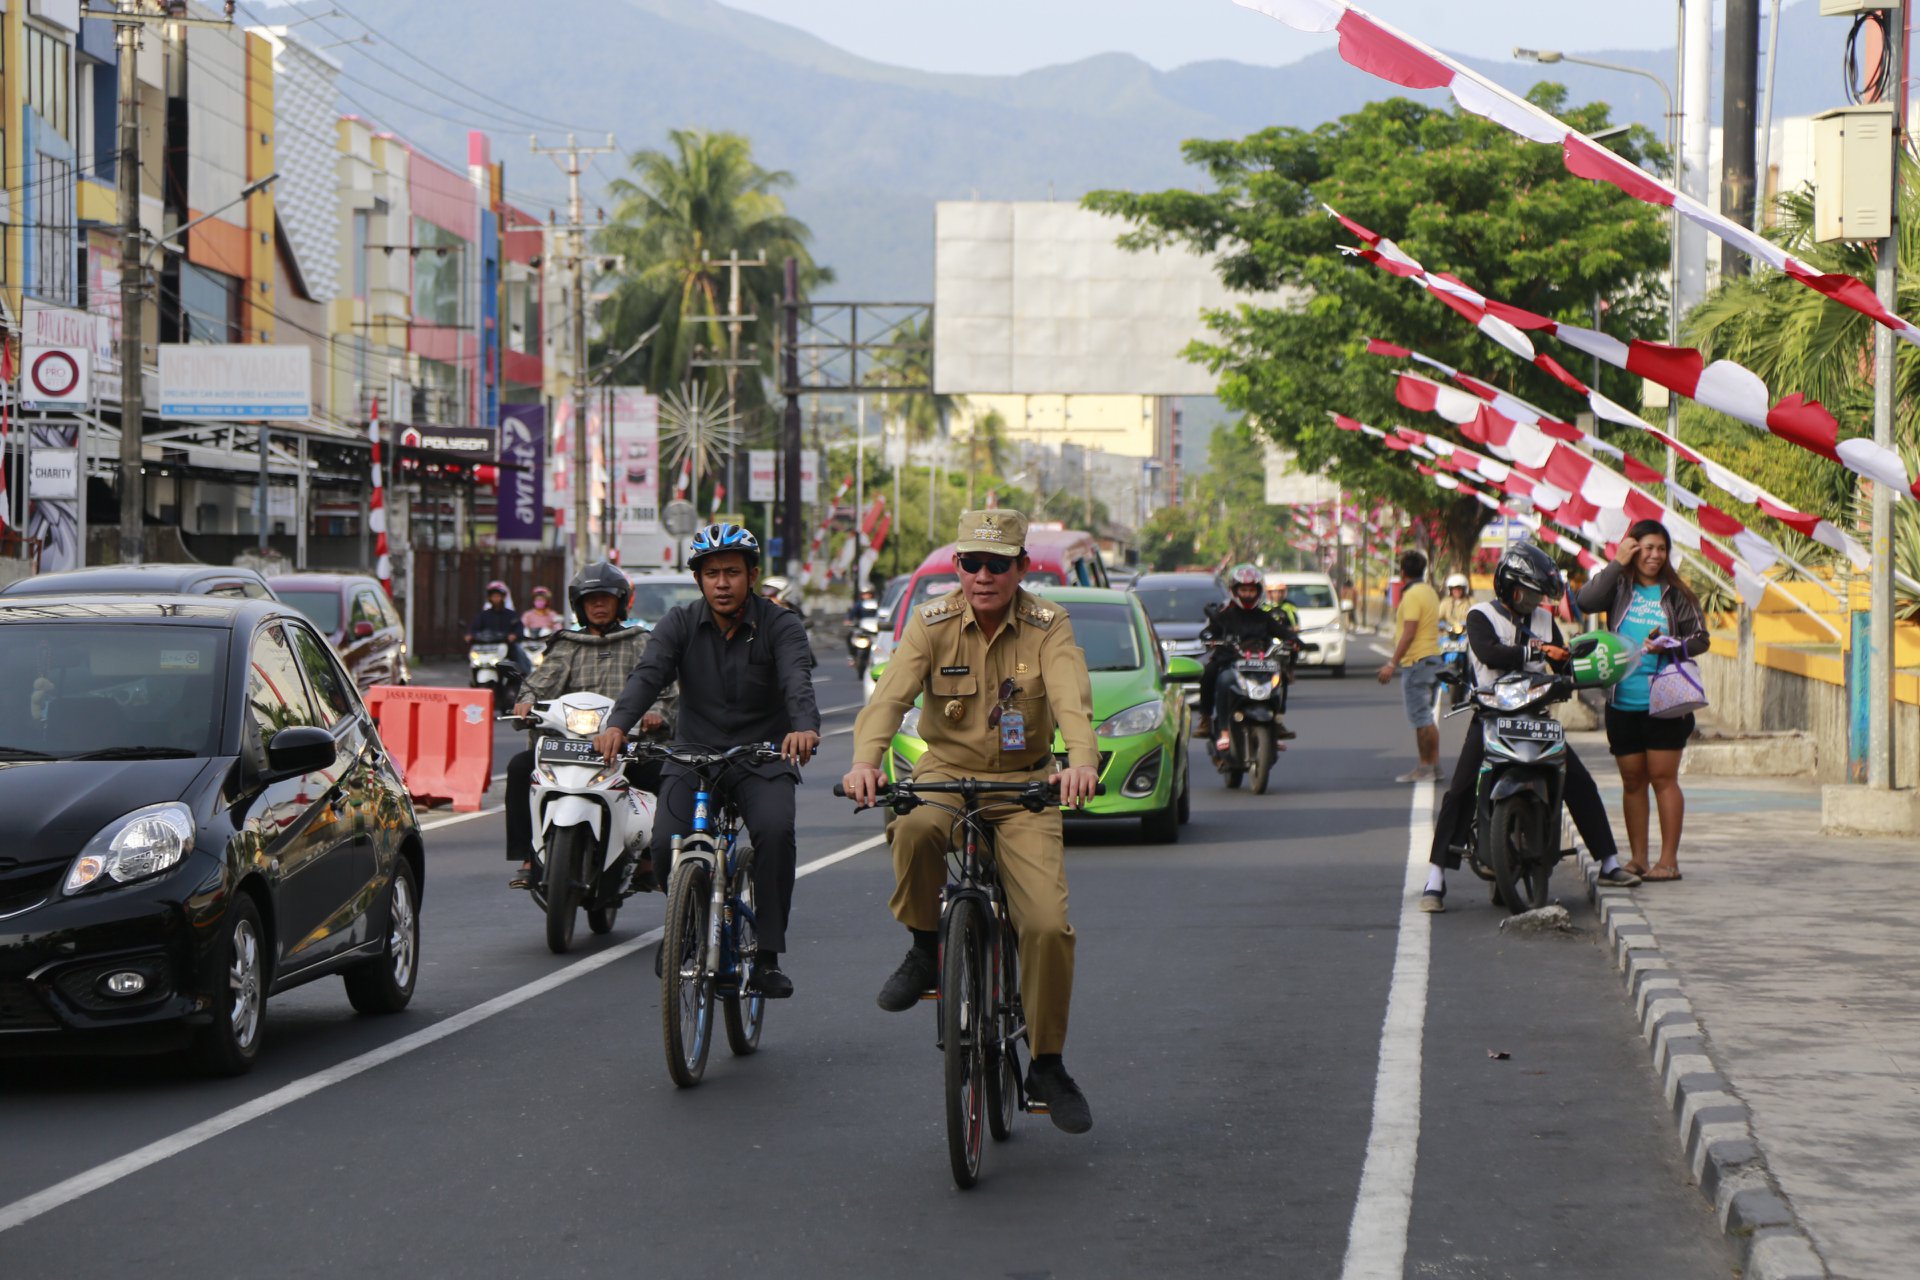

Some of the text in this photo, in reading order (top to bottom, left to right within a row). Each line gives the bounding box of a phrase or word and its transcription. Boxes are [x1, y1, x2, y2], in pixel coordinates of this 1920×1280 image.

[45, 368, 66, 378] PRO
[163, 355, 304, 388] INFINITY VARIASI
[421, 436, 489, 451] POLYGON
[35, 467, 72, 480] CHARITY
[514, 444, 536, 525] avrist
[1594, 643, 1614, 680] Grab
[385, 690, 448, 702] JASA RAHARJA
[1499, 720, 1512, 729] DB
[545, 741, 590, 753] DB 6332
